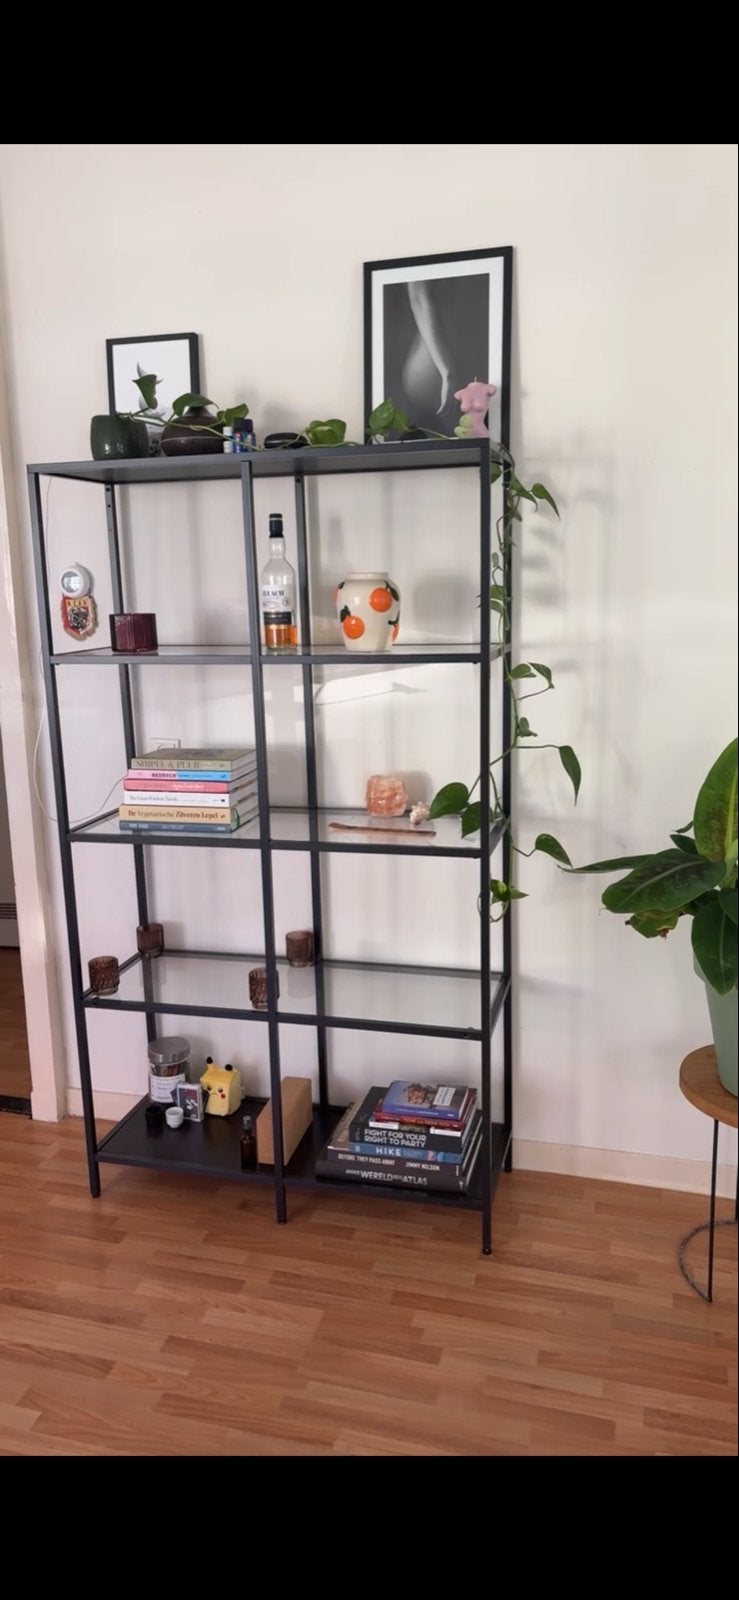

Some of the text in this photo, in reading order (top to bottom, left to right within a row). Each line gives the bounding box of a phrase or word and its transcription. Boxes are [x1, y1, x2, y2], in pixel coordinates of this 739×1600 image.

[128, 809, 136, 817] De
[201, 811, 219, 821] Lepel
[364, 1128, 427, 1142] FIGHT FOR YOUR
[364, 1135, 426, 1148] RIGHT TO PARTY
[375, 1146, 402, 1157] HIKE
[338, 1153, 355, 1161] BEFORE
[356, 1155, 368, 1163] THEY
[360, 1170, 393, 1182] WERELD
[402, 1175, 428, 1186] ATLAS
